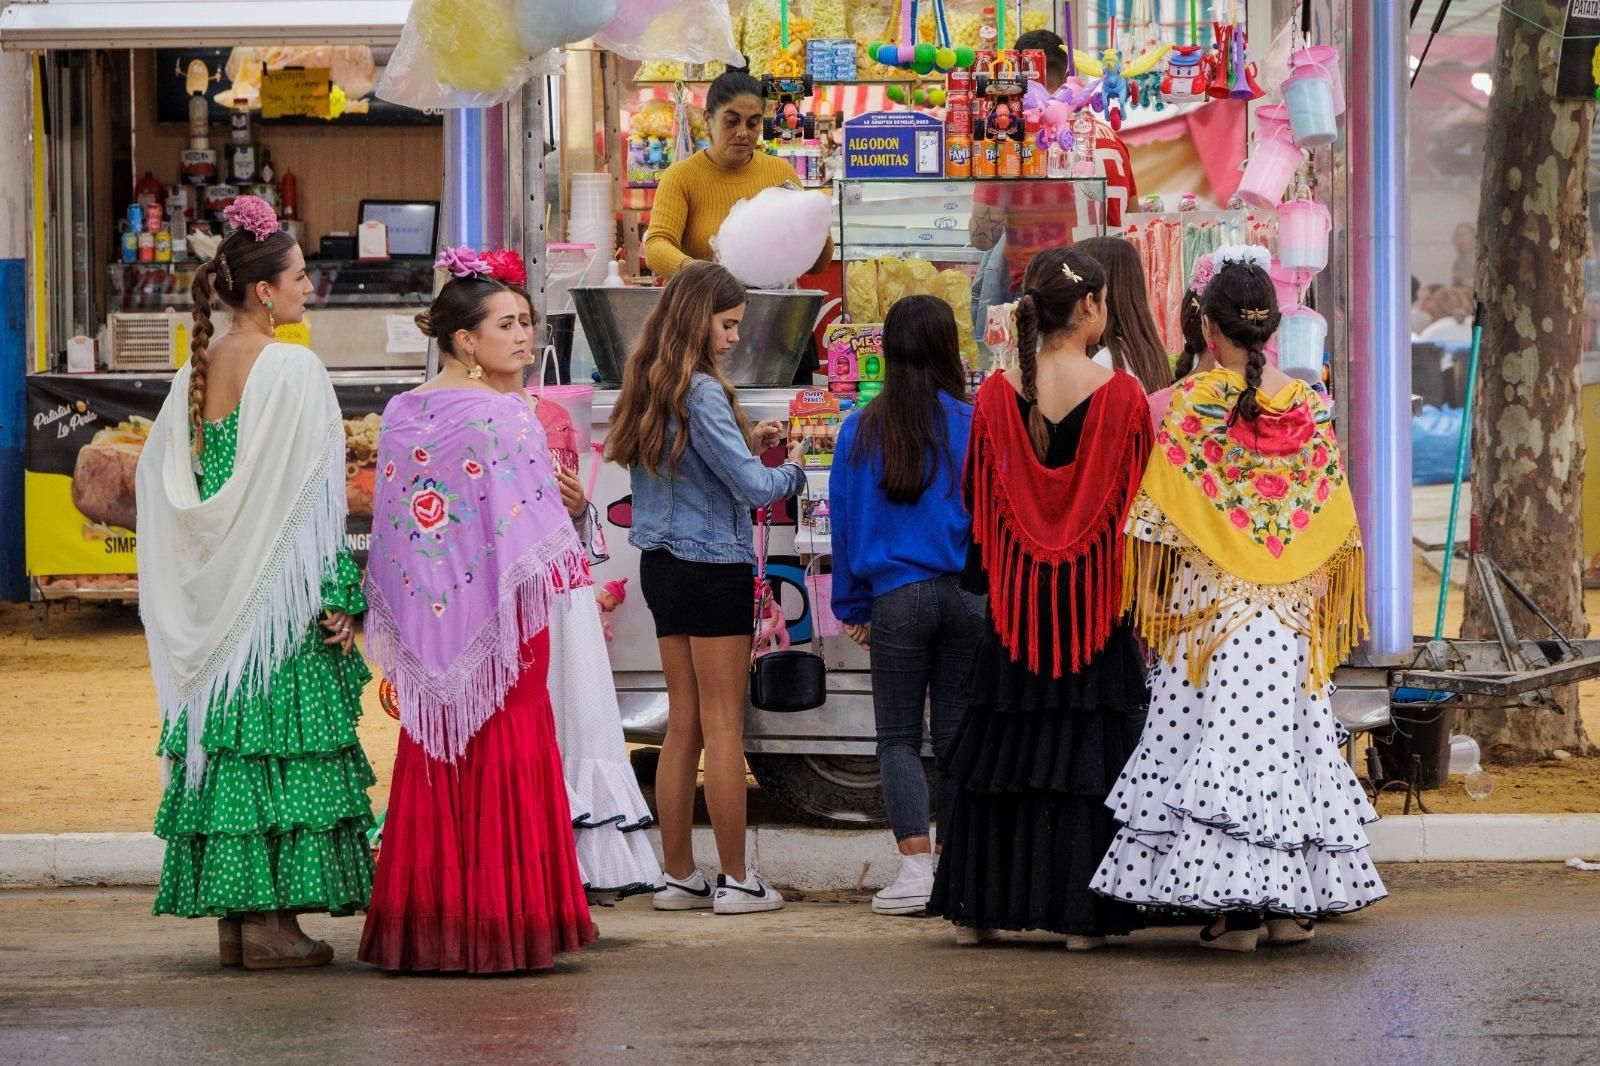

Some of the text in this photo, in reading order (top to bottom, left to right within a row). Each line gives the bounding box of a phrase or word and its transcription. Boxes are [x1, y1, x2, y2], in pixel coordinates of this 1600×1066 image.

[849, 137, 899, 150] ALGODON
[850, 154, 909, 167] PALOMITAS
[851, 335, 882, 351] MEG
[859, 347, 877, 355] ROLL
[33, 404, 71, 431] Patatas
[57, 422, 70, 439] La
